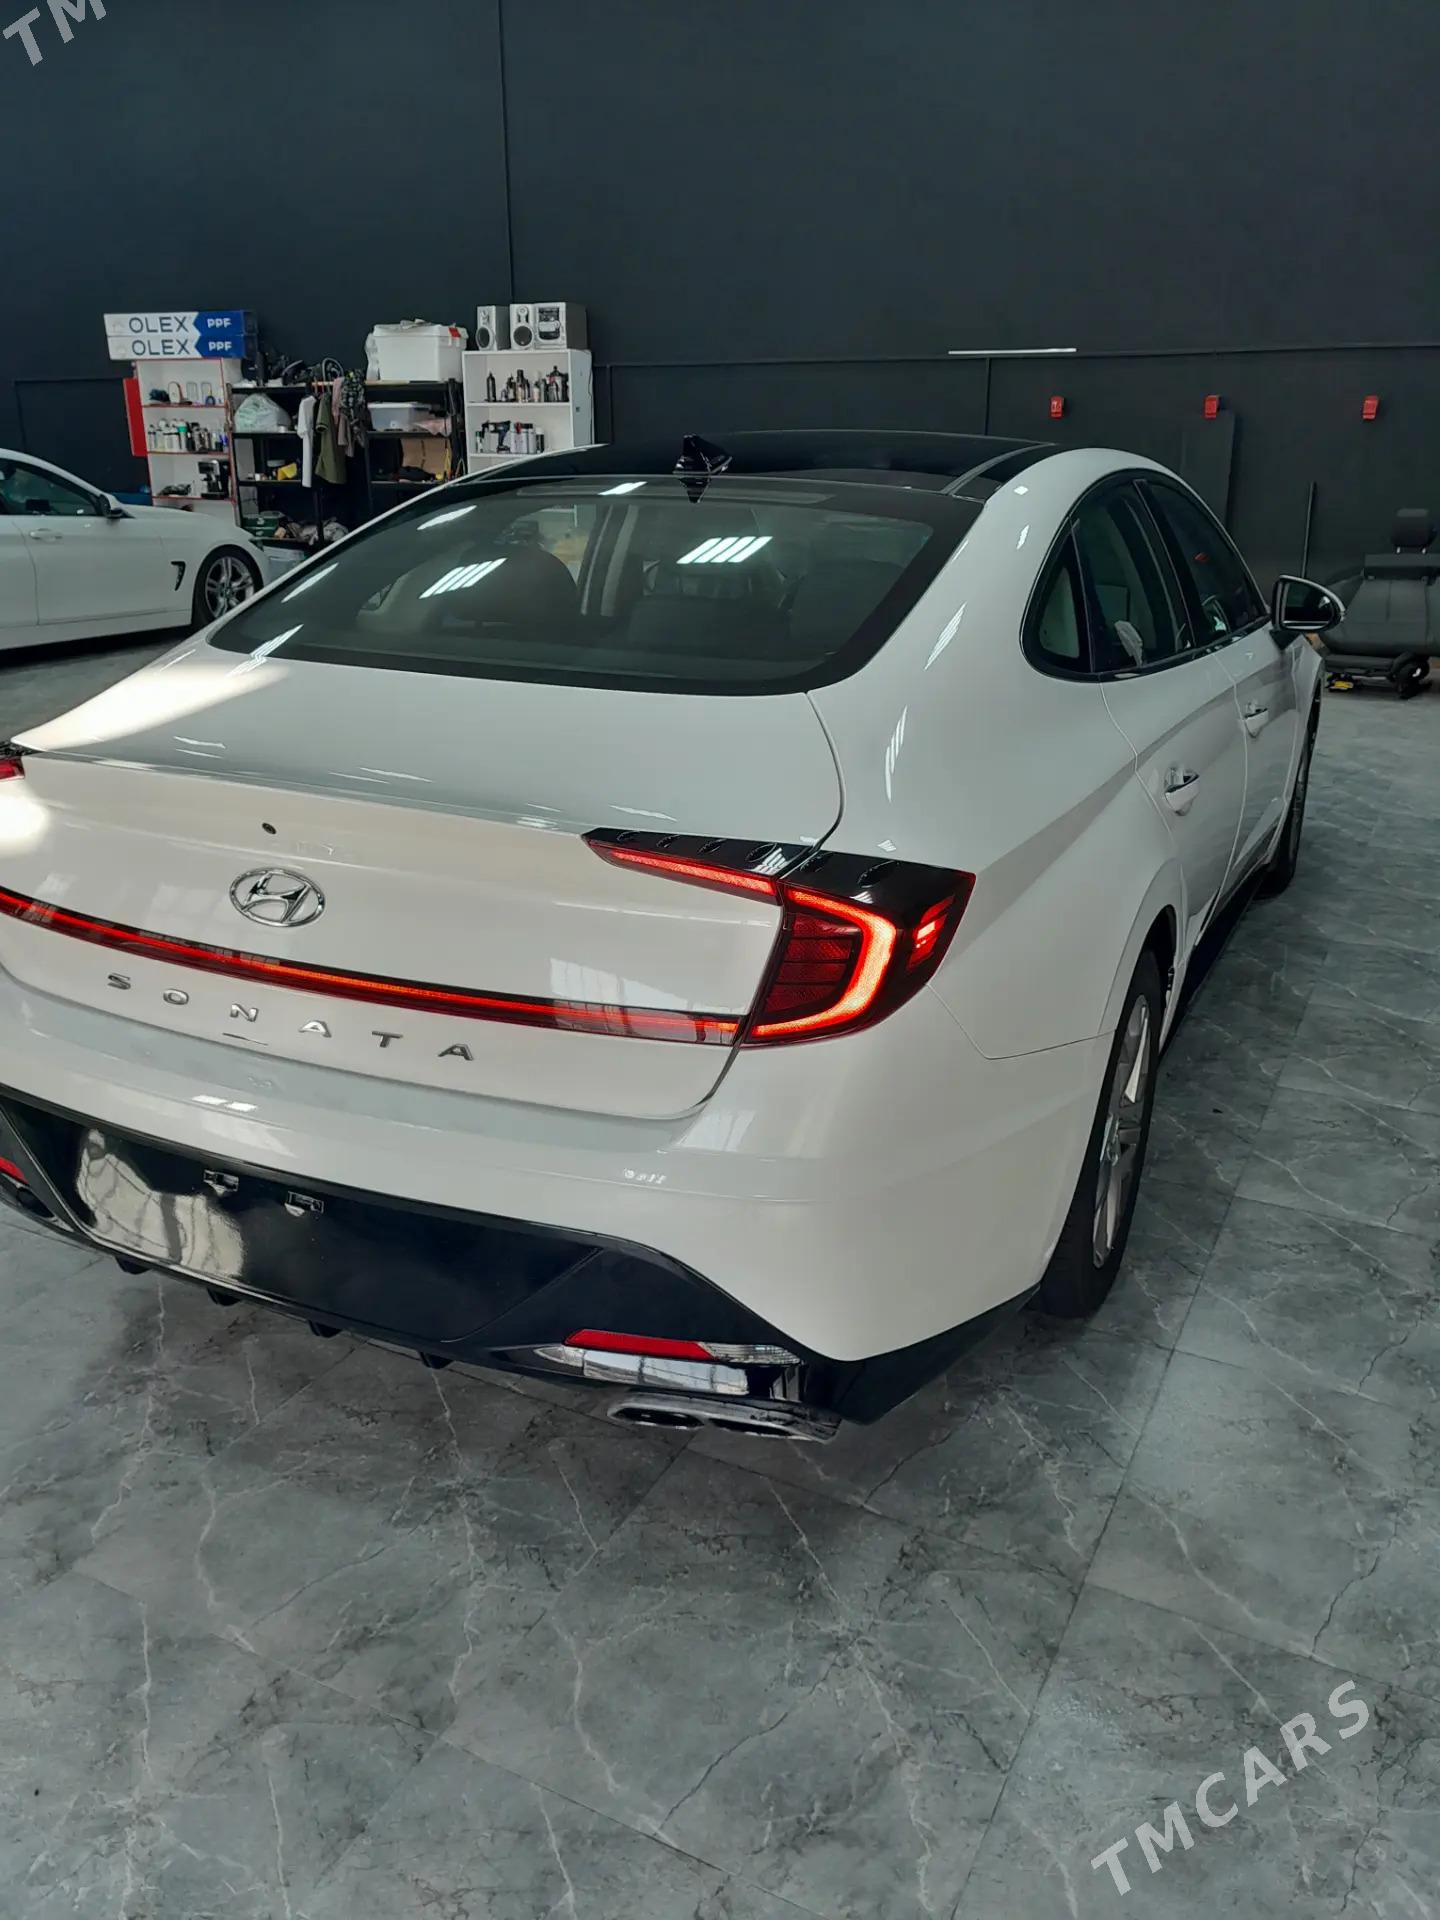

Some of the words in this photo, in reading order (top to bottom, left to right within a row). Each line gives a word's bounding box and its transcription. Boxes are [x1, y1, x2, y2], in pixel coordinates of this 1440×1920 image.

[129, 316, 189, 334] OLEX
[207, 318, 232, 329] PPF
[131, 339, 190, 356] OLEX
[208, 341, 232, 352] PPF
[107, 972, 474, 1062] SONATA
